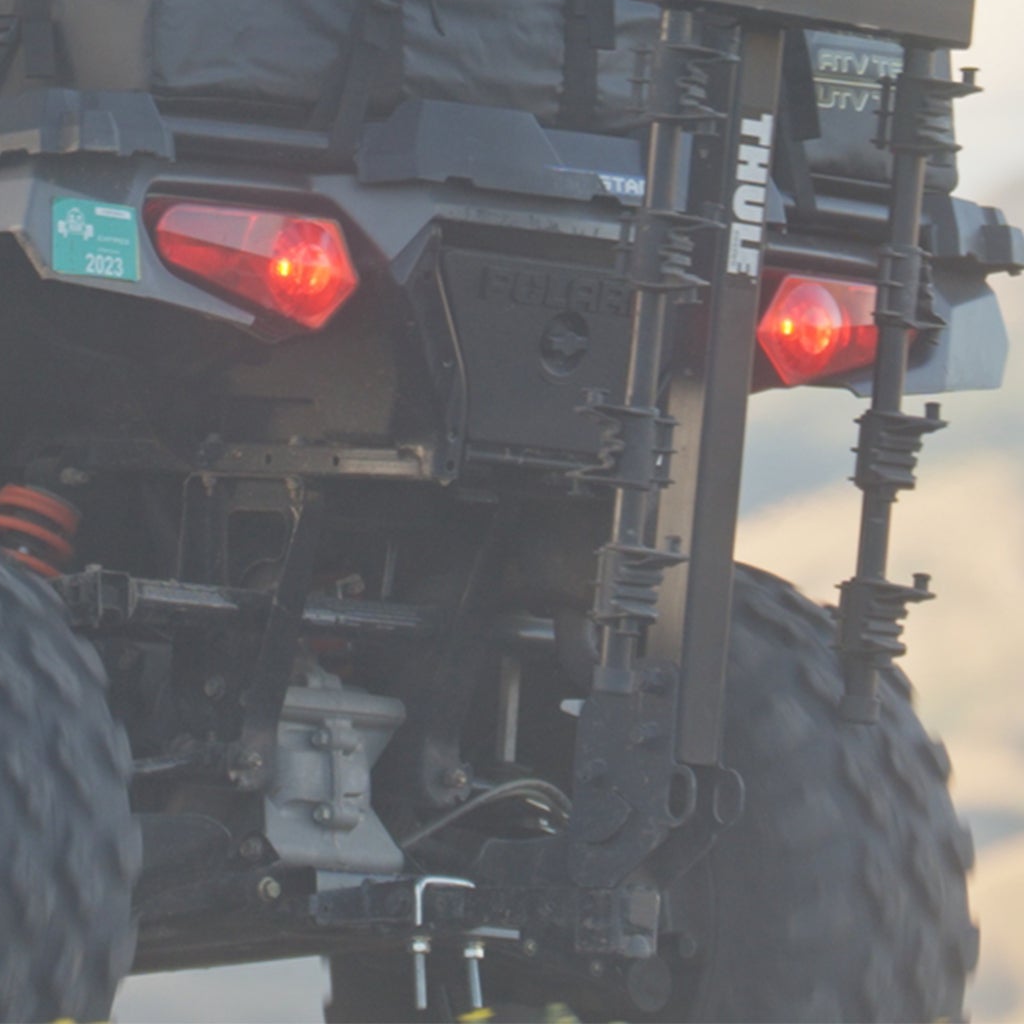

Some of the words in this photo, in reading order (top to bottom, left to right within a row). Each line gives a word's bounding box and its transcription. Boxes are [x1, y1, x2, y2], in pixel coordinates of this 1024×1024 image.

[817, 50, 869, 76] ATV
[871, 55, 903, 80] TE
[816, 84, 869, 112] UTV
[727, 113, 774, 277] THULE
[85, 253, 124, 277] 2023
